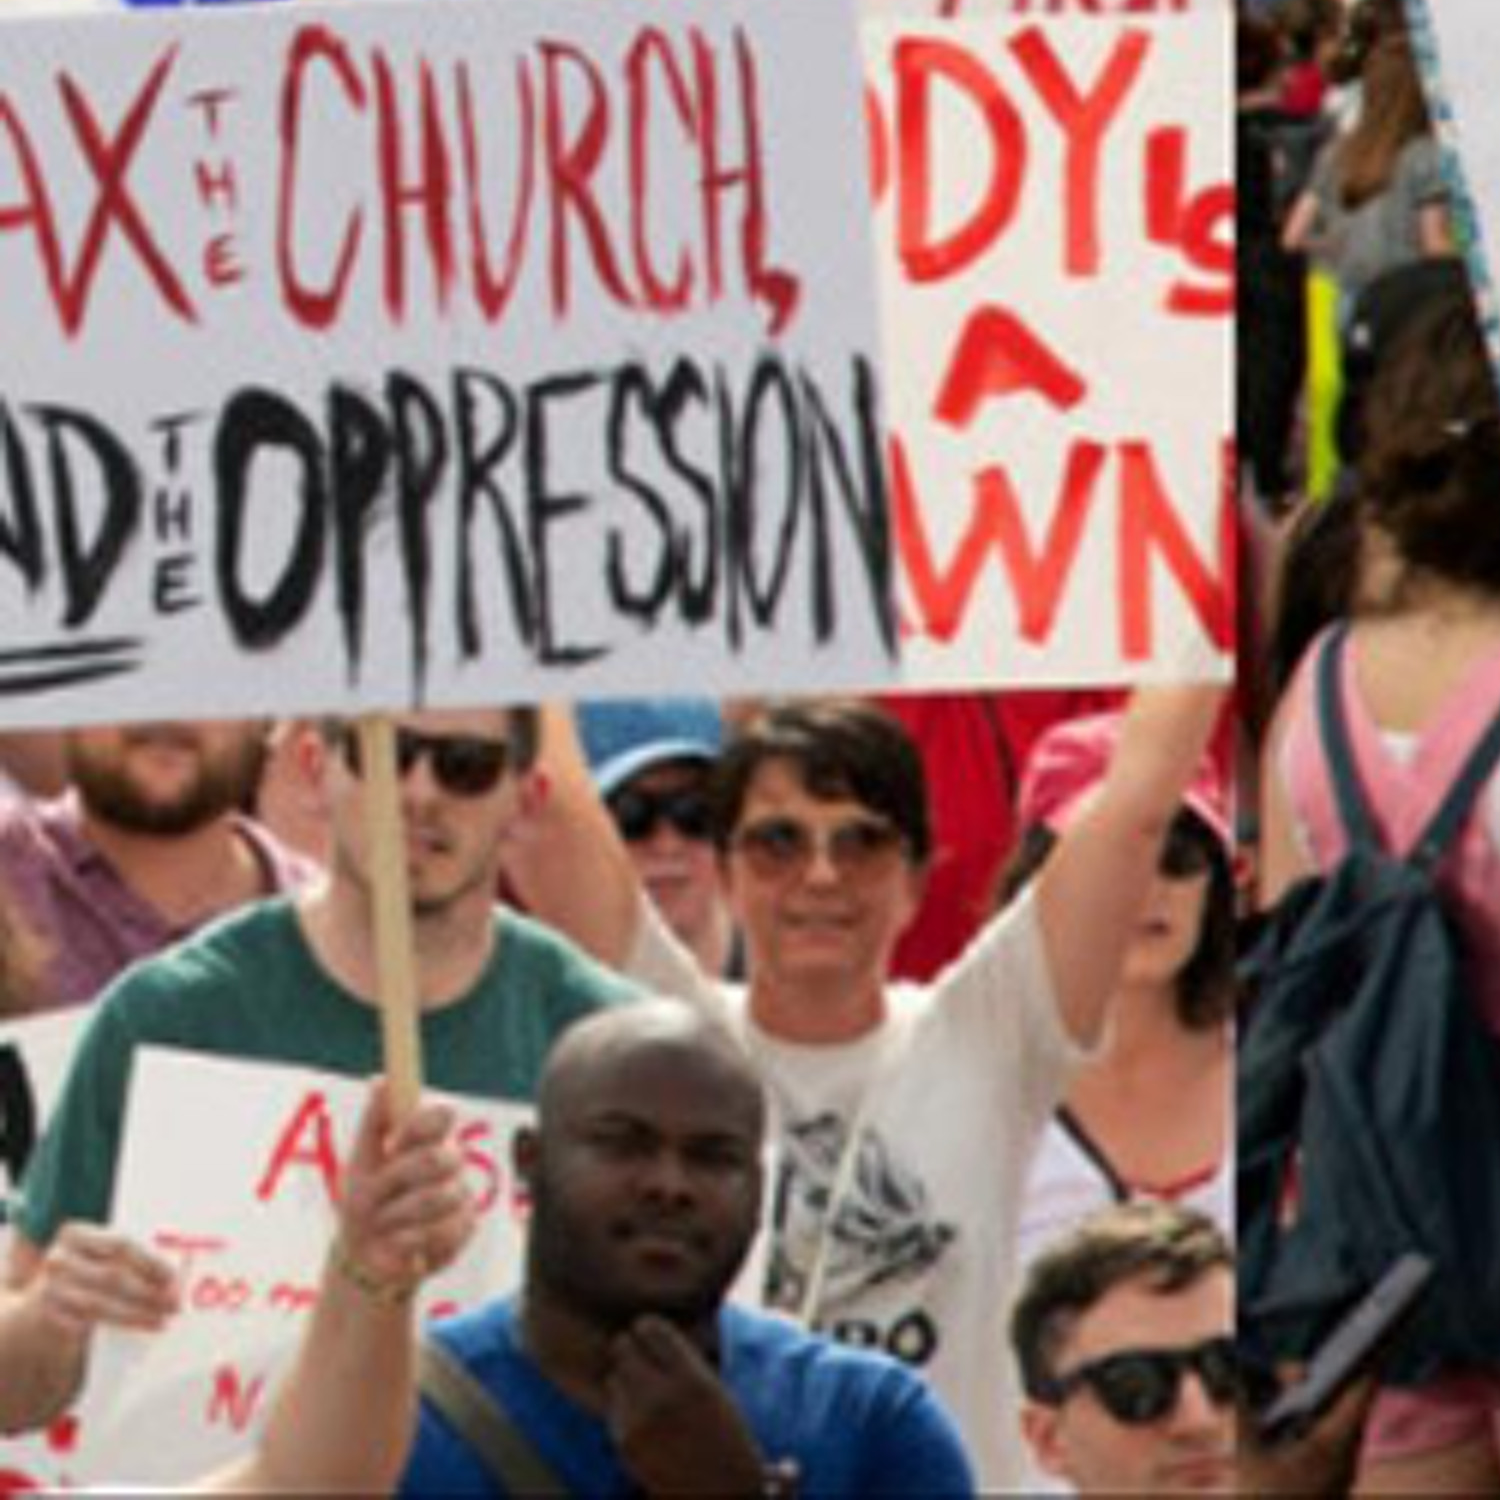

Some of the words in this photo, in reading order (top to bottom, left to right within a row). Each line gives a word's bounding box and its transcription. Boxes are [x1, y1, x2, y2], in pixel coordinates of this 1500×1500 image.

[188, 88, 246, 288] THE
[277, 22, 801, 340] CHURCH,
[149, 410, 208, 615] THE
[212, 350, 897, 704] OPPRESSION
[933, 304, 1087, 434] A
